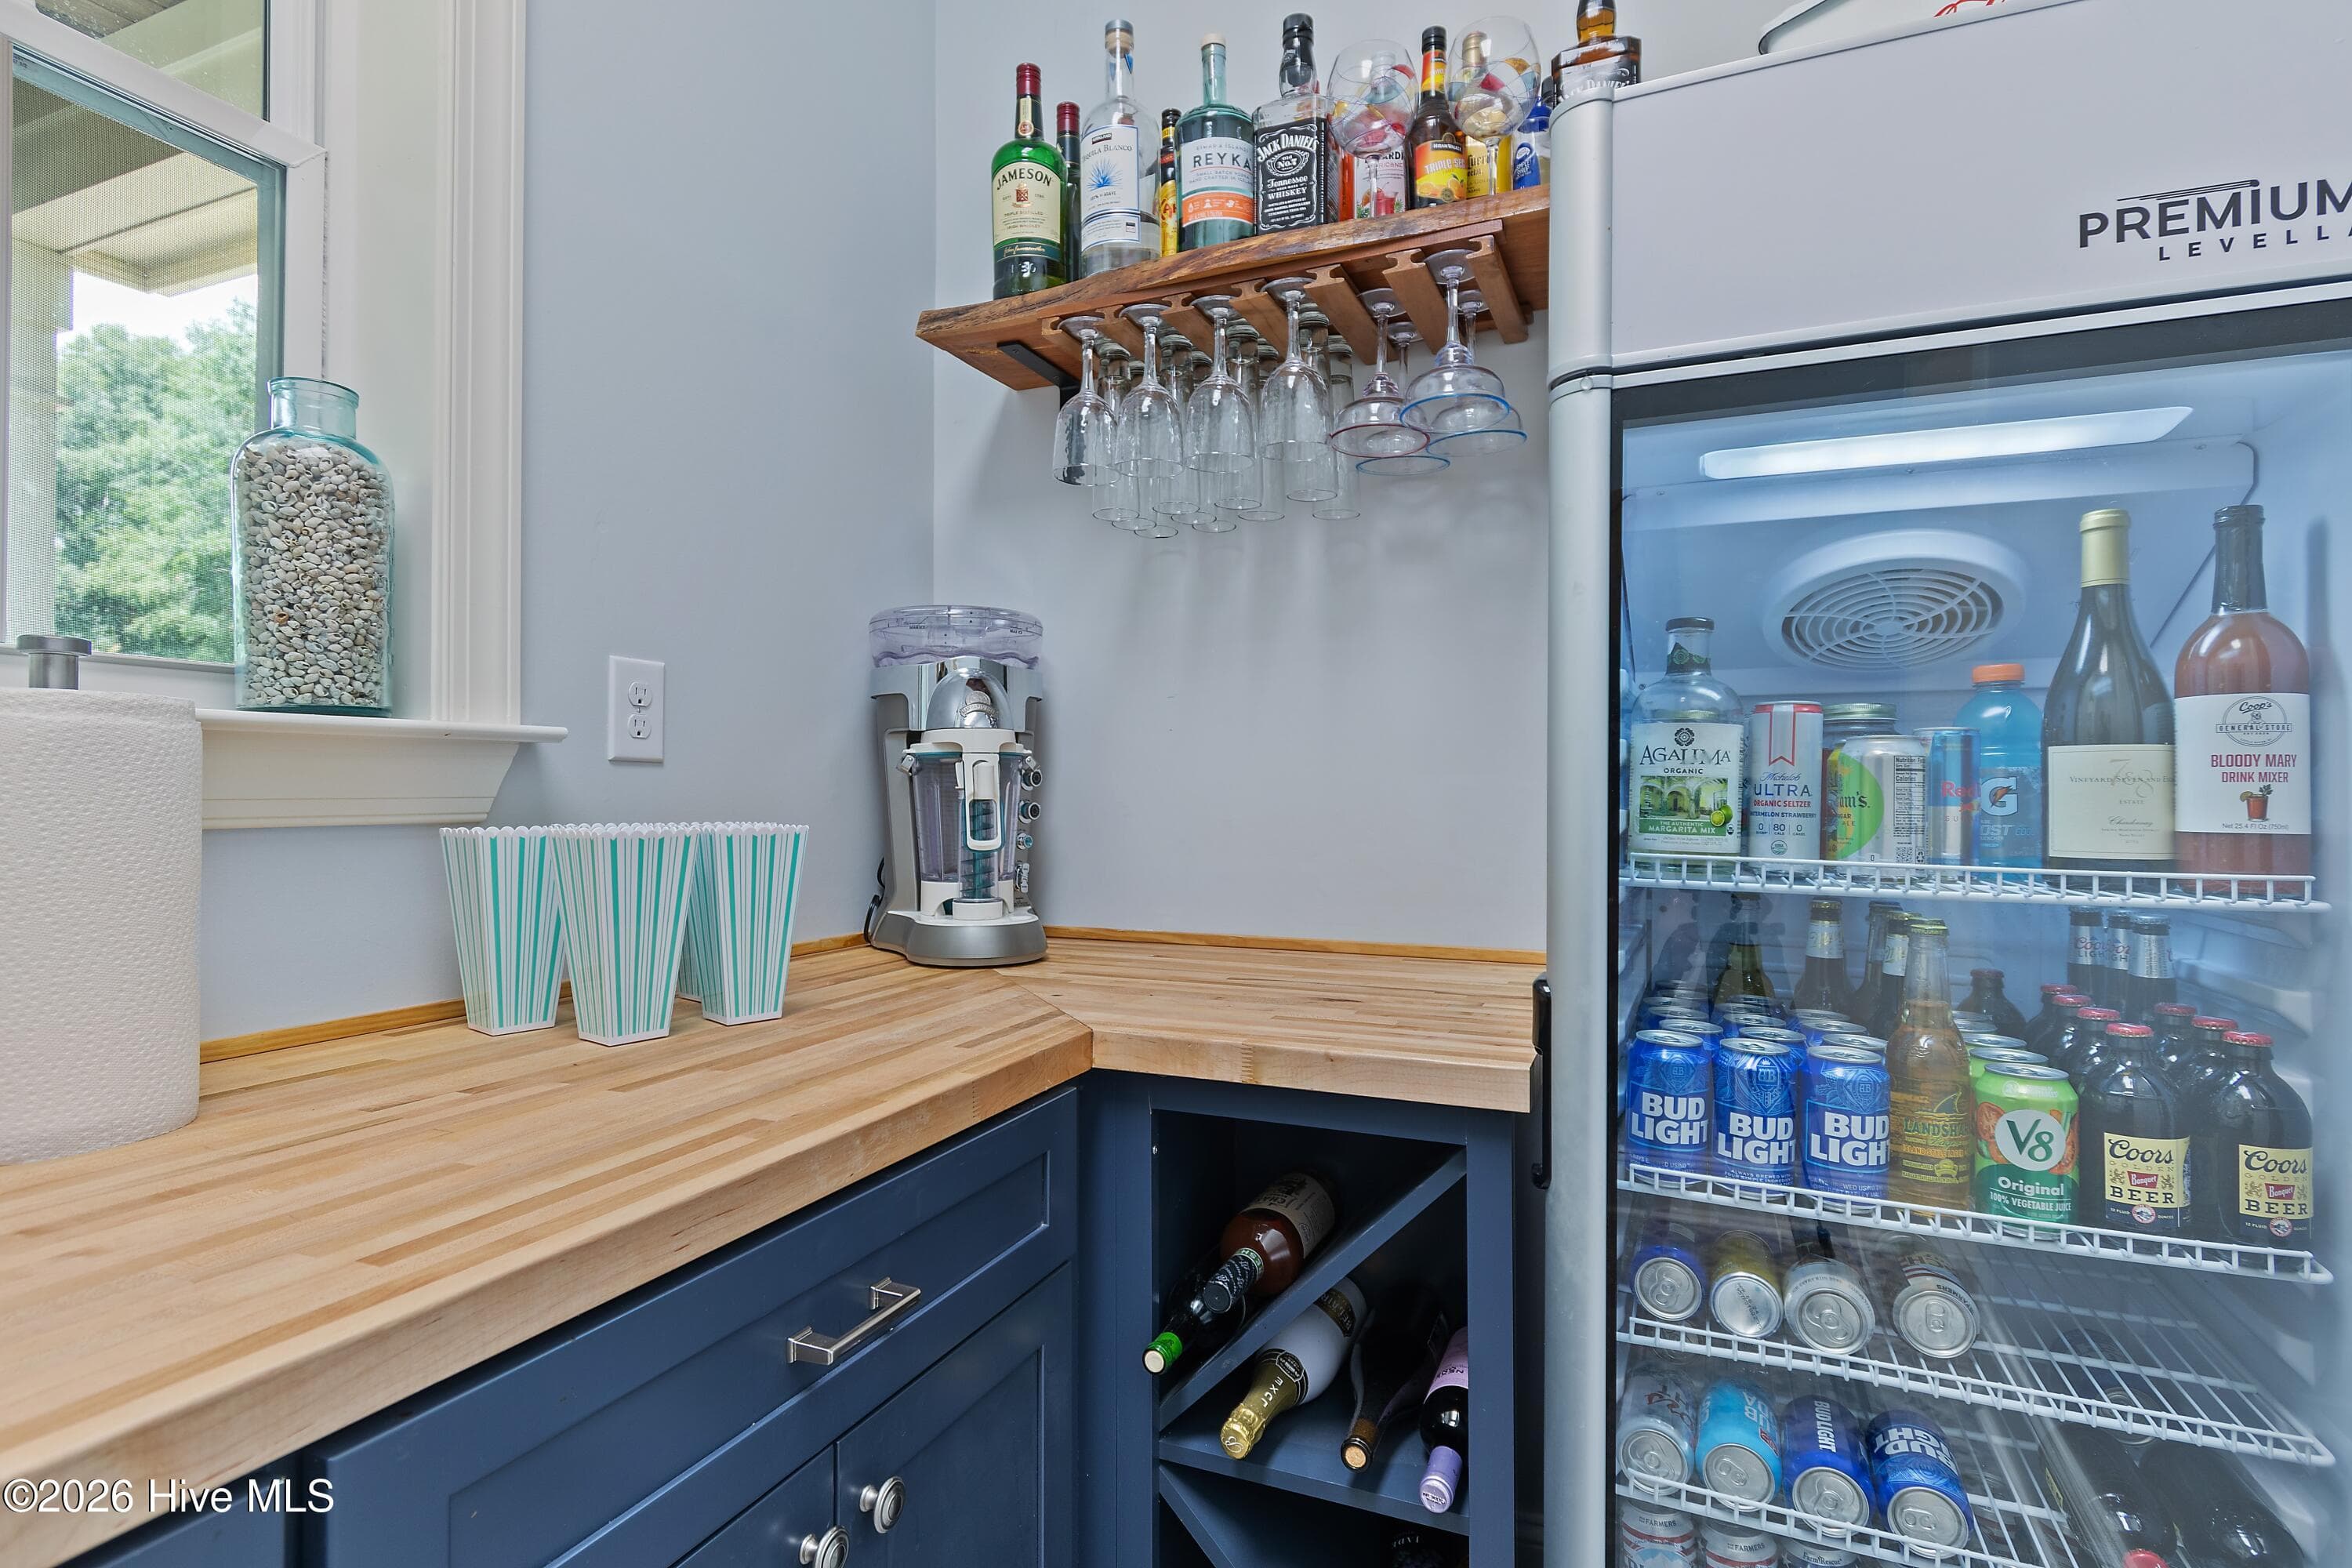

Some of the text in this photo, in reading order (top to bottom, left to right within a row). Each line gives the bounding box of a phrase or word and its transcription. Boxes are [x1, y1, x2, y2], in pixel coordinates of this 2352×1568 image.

[1258, 139, 1280, 162] JACK
[1193, 152, 1251, 171] REYKA
[1277, 158, 1298, 169] No.7
[1425, 158, 1452, 174] TRIPLE
[996, 168, 1052, 191] JAMESON
[1267, 176, 1308, 188] Tennessee
[1268, 187, 1307, 199] WHISKEY
[2079, 179, 2352, 249] PREMIUM
[2158, 225, 2352, 262] LEVELL
[2238, 701, 2272, 713] Coop's
[2211, 753, 2297, 768] BLOODY MARY
[1760, 771, 1802, 782] Michelob
[2221, 771, 2288, 783] DRINK MIXER
[1754, 783, 1812, 797] ULTRA
[1649, 825, 1698, 833] MARGARITA
[1758, 822, 1764, 831] 0
[1773, 823, 1786, 832] 80
[1642, 1091, 1705, 1120] BUD
[1632, 1112, 1709, 1145] LIGHT
[1730, 1112, 1794, 1141] BUD
[1824, 1111, 1889, 1141] BUD
[2005, 1118, 2054, 1163] V8
[2107, 1138, 2174, 1164] Coors
[2109, 1160, 2174, 1172] GOLDEN
[2243, 1150, 2307, 1174] Coors
[1731, 1169, 1755, 1178] ALWAYS
[2131, 1173, 2157, 1186] Banquet
[1998, 1176, 2064, 1196] Original
[2269, 1185, 2294, 1198] Banquet
[1990, 1191, 2072, 1211] 100% VEGETABLE JUICE
[2110, 1185, 2175, 1204] BEER
[2245, 1198, 2309, 1215] BEER
[1813, 1400, 1837, 1453] BUD LIGHT
[1885, 1439, 1958, 1475] BUD
[1645, 1518, 1677, 1528] FARMERS
[1733, 1542, 1766, 1553] FARMERS
[1802, 1552, 1842, 1566] Farm Rescue
